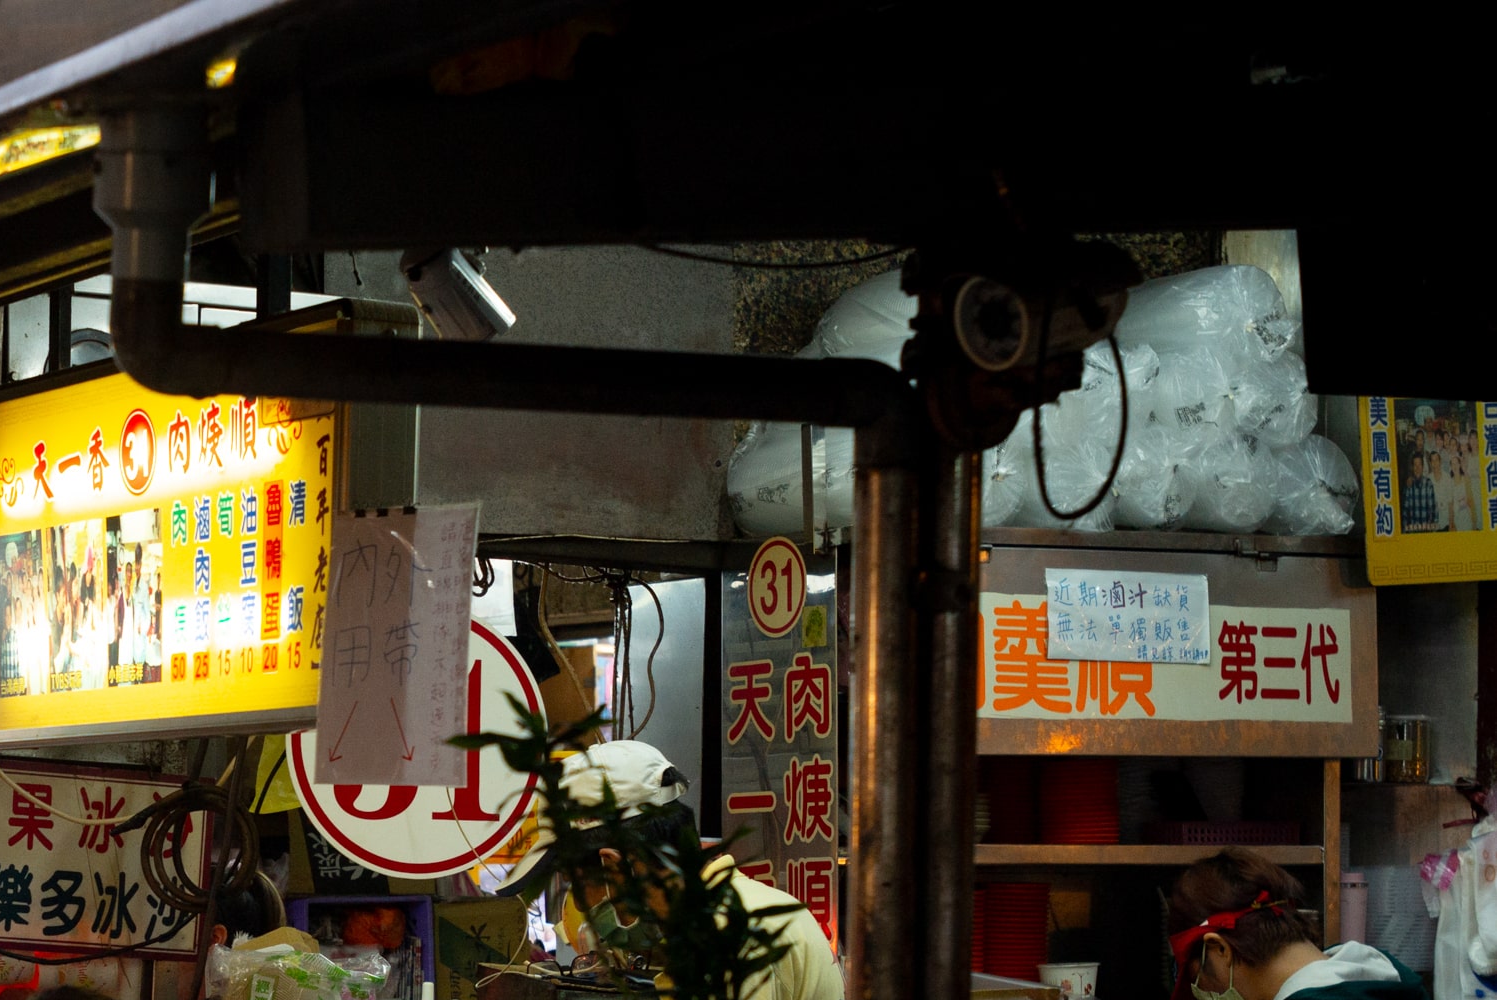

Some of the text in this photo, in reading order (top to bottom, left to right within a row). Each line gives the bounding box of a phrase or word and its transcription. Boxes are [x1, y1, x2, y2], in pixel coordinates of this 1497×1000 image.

[32, 429, 110, 503] 天一香
[124, 426, 151, 485] 31
[1369, 396, 1394, 537] 美鳳有約
[194, 496, 211, 642] 滷肉飯
[759, 557, 794, 616] 31
[1054, 577, 1190, 613] 近期滷汁缺貨
[1056, 613, 1191, 644] 無法單獨販售
[173, 656, 186, 680] 50
[195, 654, 209, 679] 25
[218, 650, 231, 676] 15
[241, 647, 254, 673] 10
[263, 645, 277, 670] 20
[288, 641, 301, 669] 15
[1218, 620, 1341, 705] 第三代
